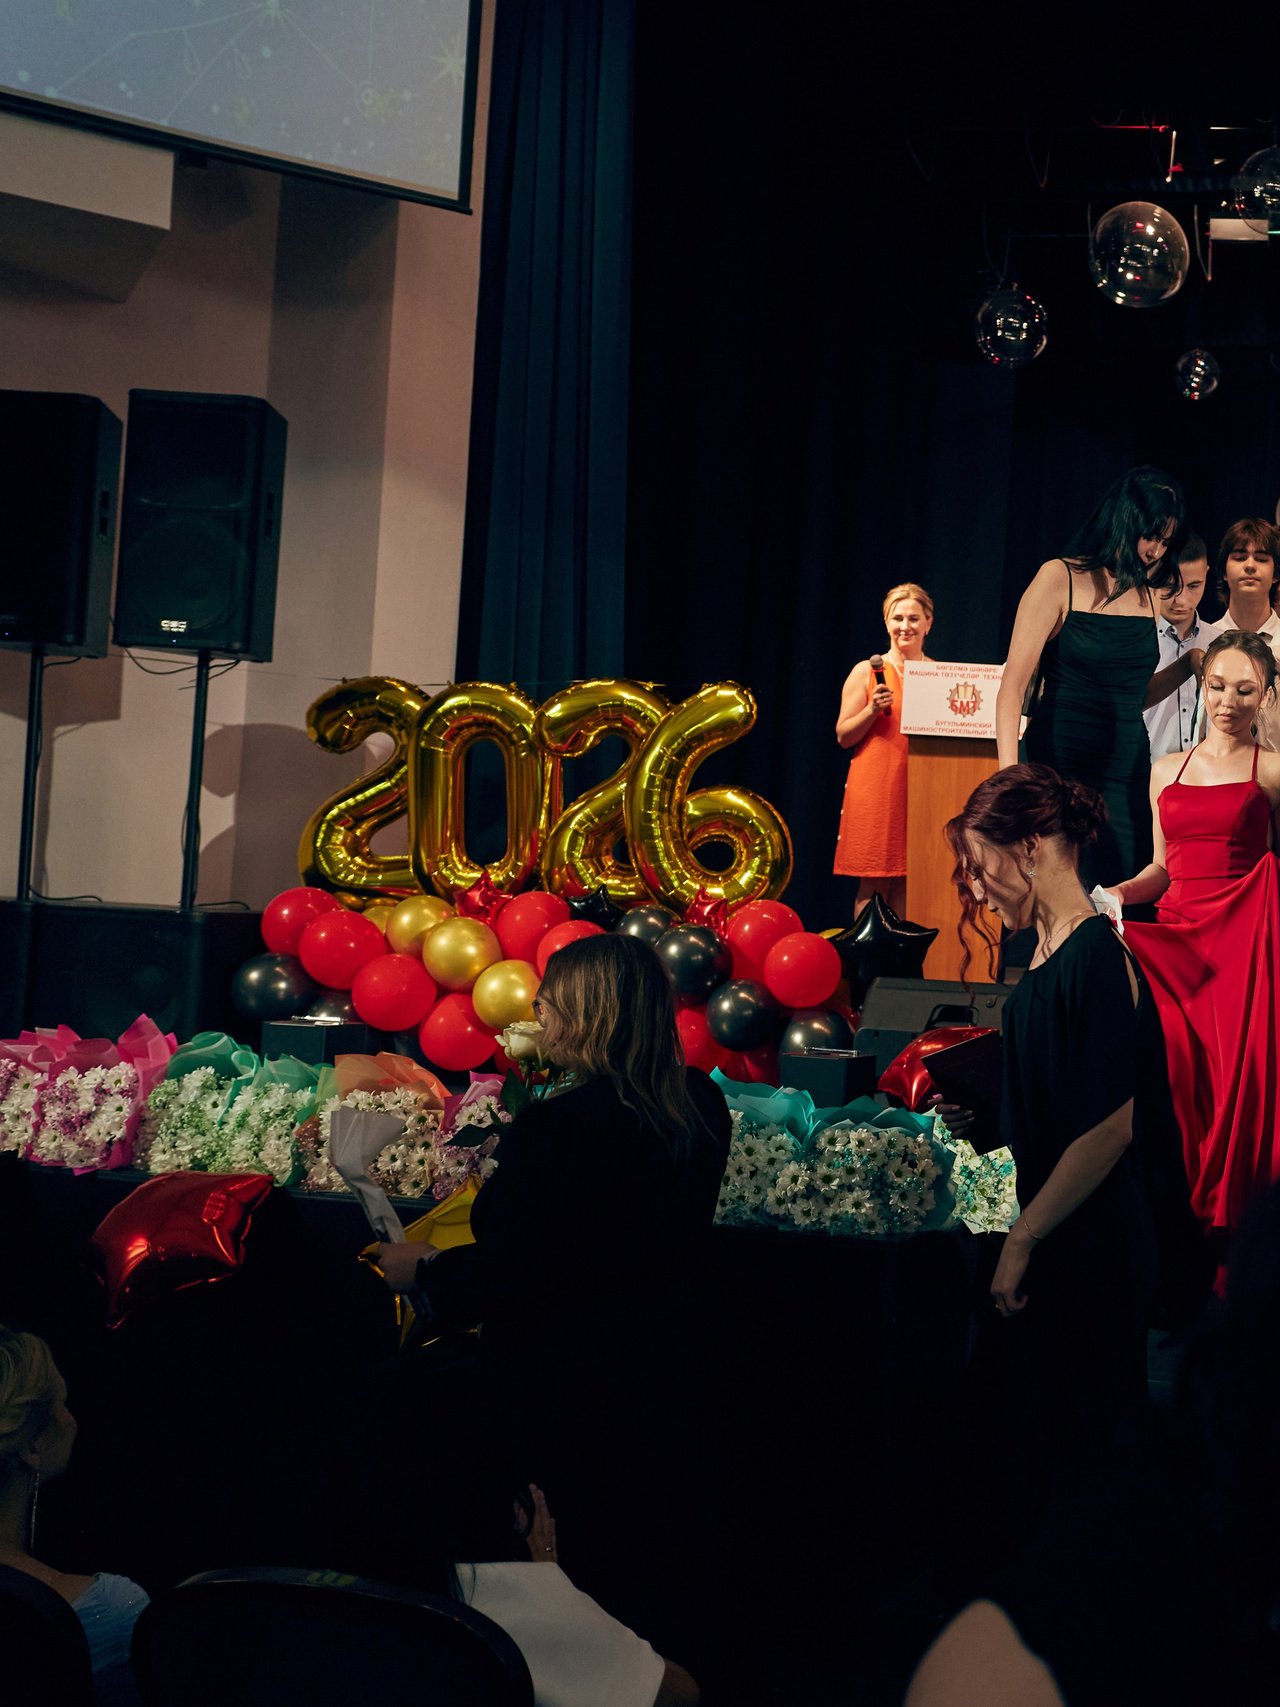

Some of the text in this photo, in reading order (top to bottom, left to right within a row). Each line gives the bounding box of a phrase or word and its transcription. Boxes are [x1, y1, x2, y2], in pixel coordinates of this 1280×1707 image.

[950, 699, 978, 716] БМТ
[903, 726, 988, 736] МАШИНОСТРОИТЕЛЬНЫЙ
[935, 720, 992, 729] БУГУЛЬМИНСКИЙ
[298, 675, 794, 908] 2026
